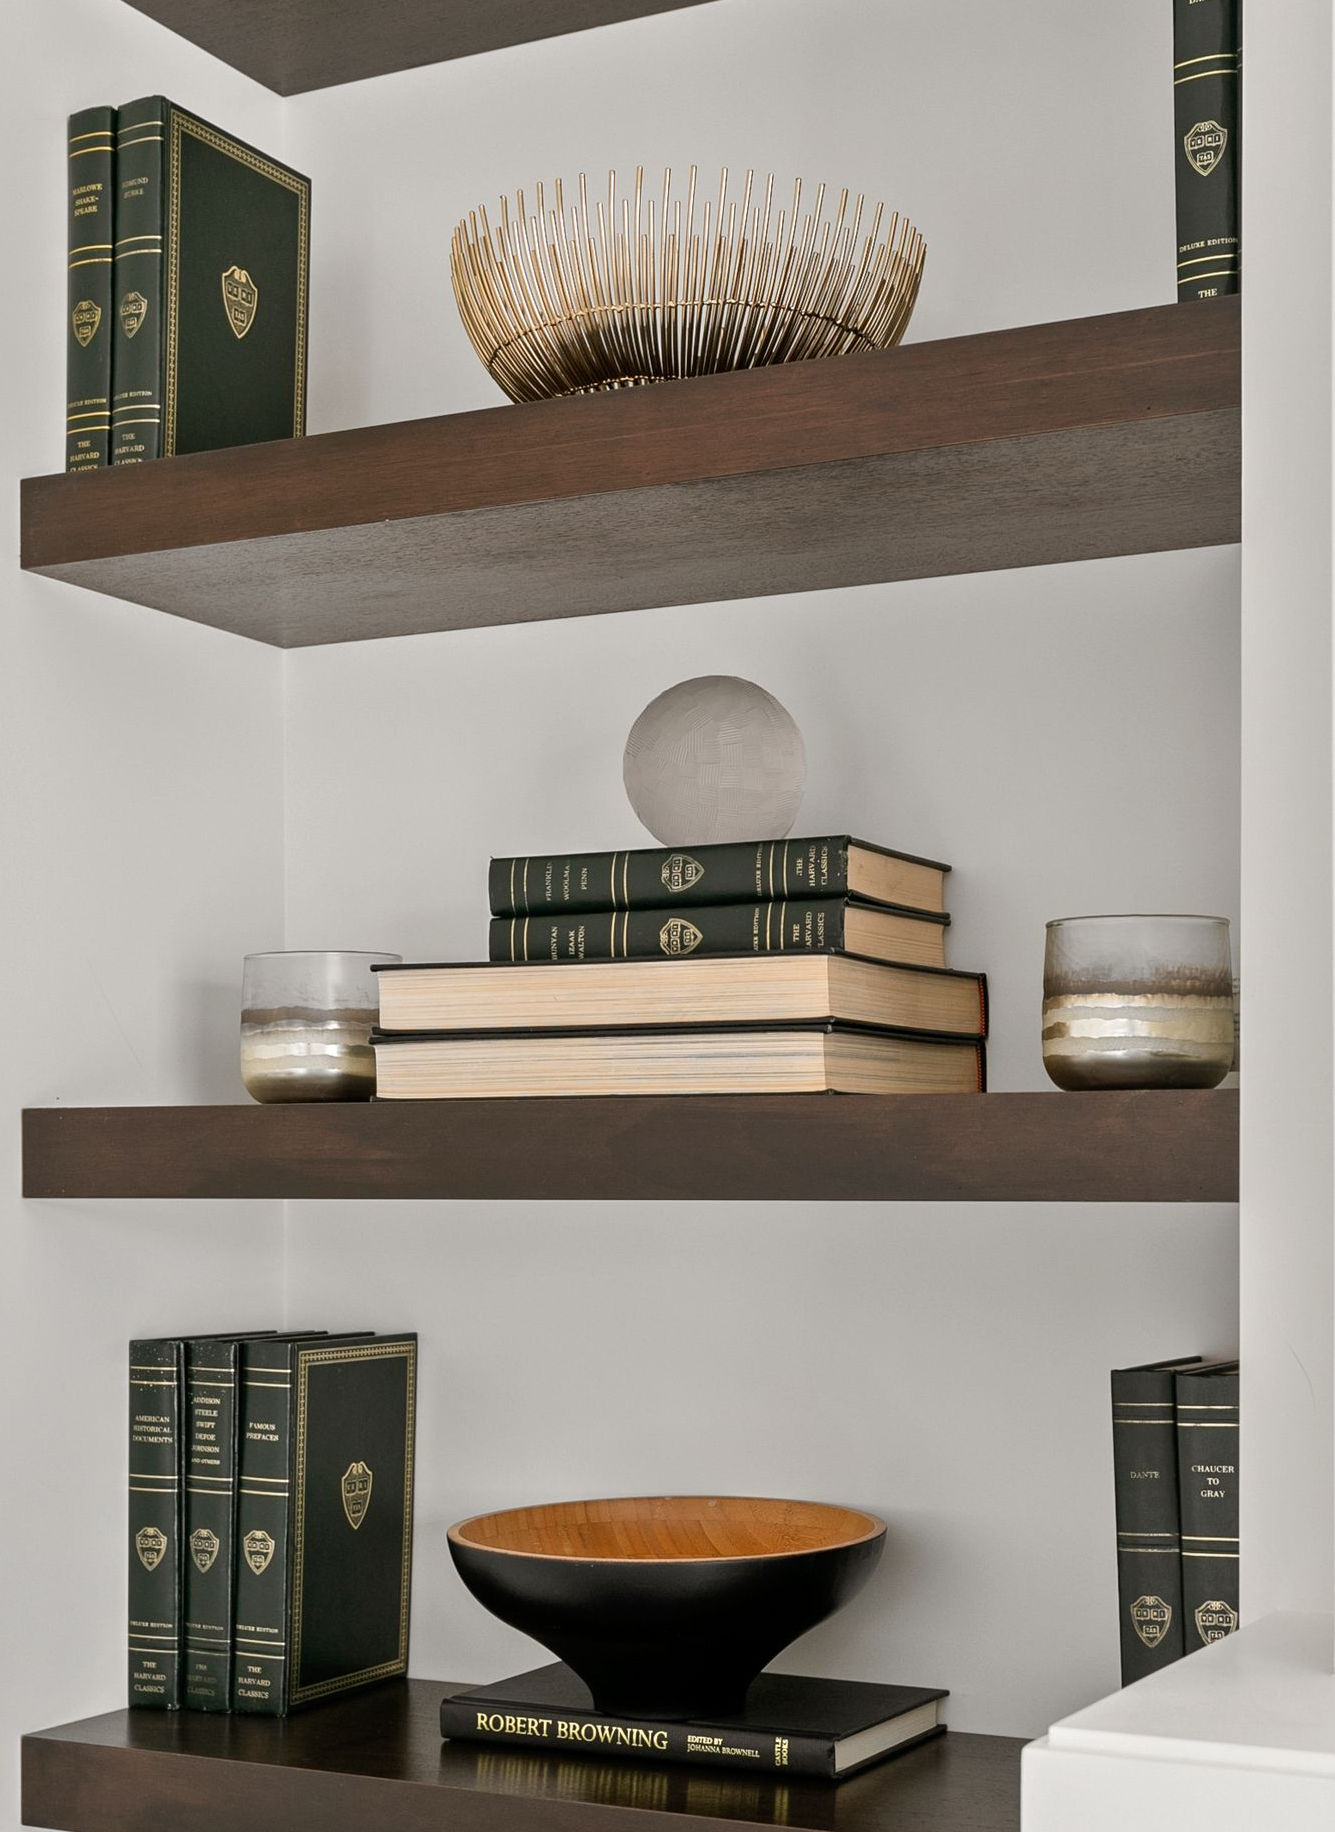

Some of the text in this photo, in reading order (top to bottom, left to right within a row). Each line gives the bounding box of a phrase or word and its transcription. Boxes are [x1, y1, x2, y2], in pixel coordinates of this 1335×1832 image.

[73, 183, 102, 195] MARLOWE
[74, 206, 97, 216] SPEARE
[1179, 241, 1205, 252] DELUXE
[1198, 288, 1217, 298] THE
[115, 445, 144, 454] HARVARD
[70, 452, 100, 462] HARVARD
[194, 1397, 220, 1405] ADDISON
[250, 1422, 275, 1430] FAMOUS
[133, 1435, 173, 1443] DOCUMENTS
[246, 1433, 279, 1441] PREFACES
[192, 1445, 220, 1453] JOHNSON
[1191, 1465, 1235, 1473] CHAUCER
[1130, 1471, 1160, 1479] DANTE
[1207, 1478, 1219, 1486] TO
[1200, 1490, 1225, 1498] GRAY
[134, 1673, 166, 1681] HARVARD
[238, 1677, 271, 1687] HARVARD
[134, 1684, 165, 1693] CLASSICS
[238, 1689, 269, 1699] CLASSICS
[476, 1712, 668, 1750] ROBERT BROWNING
[687, 1735, 713, 1744] EDITED
[687, 1744, 760, 1758] JOHANNA BROWNELL
